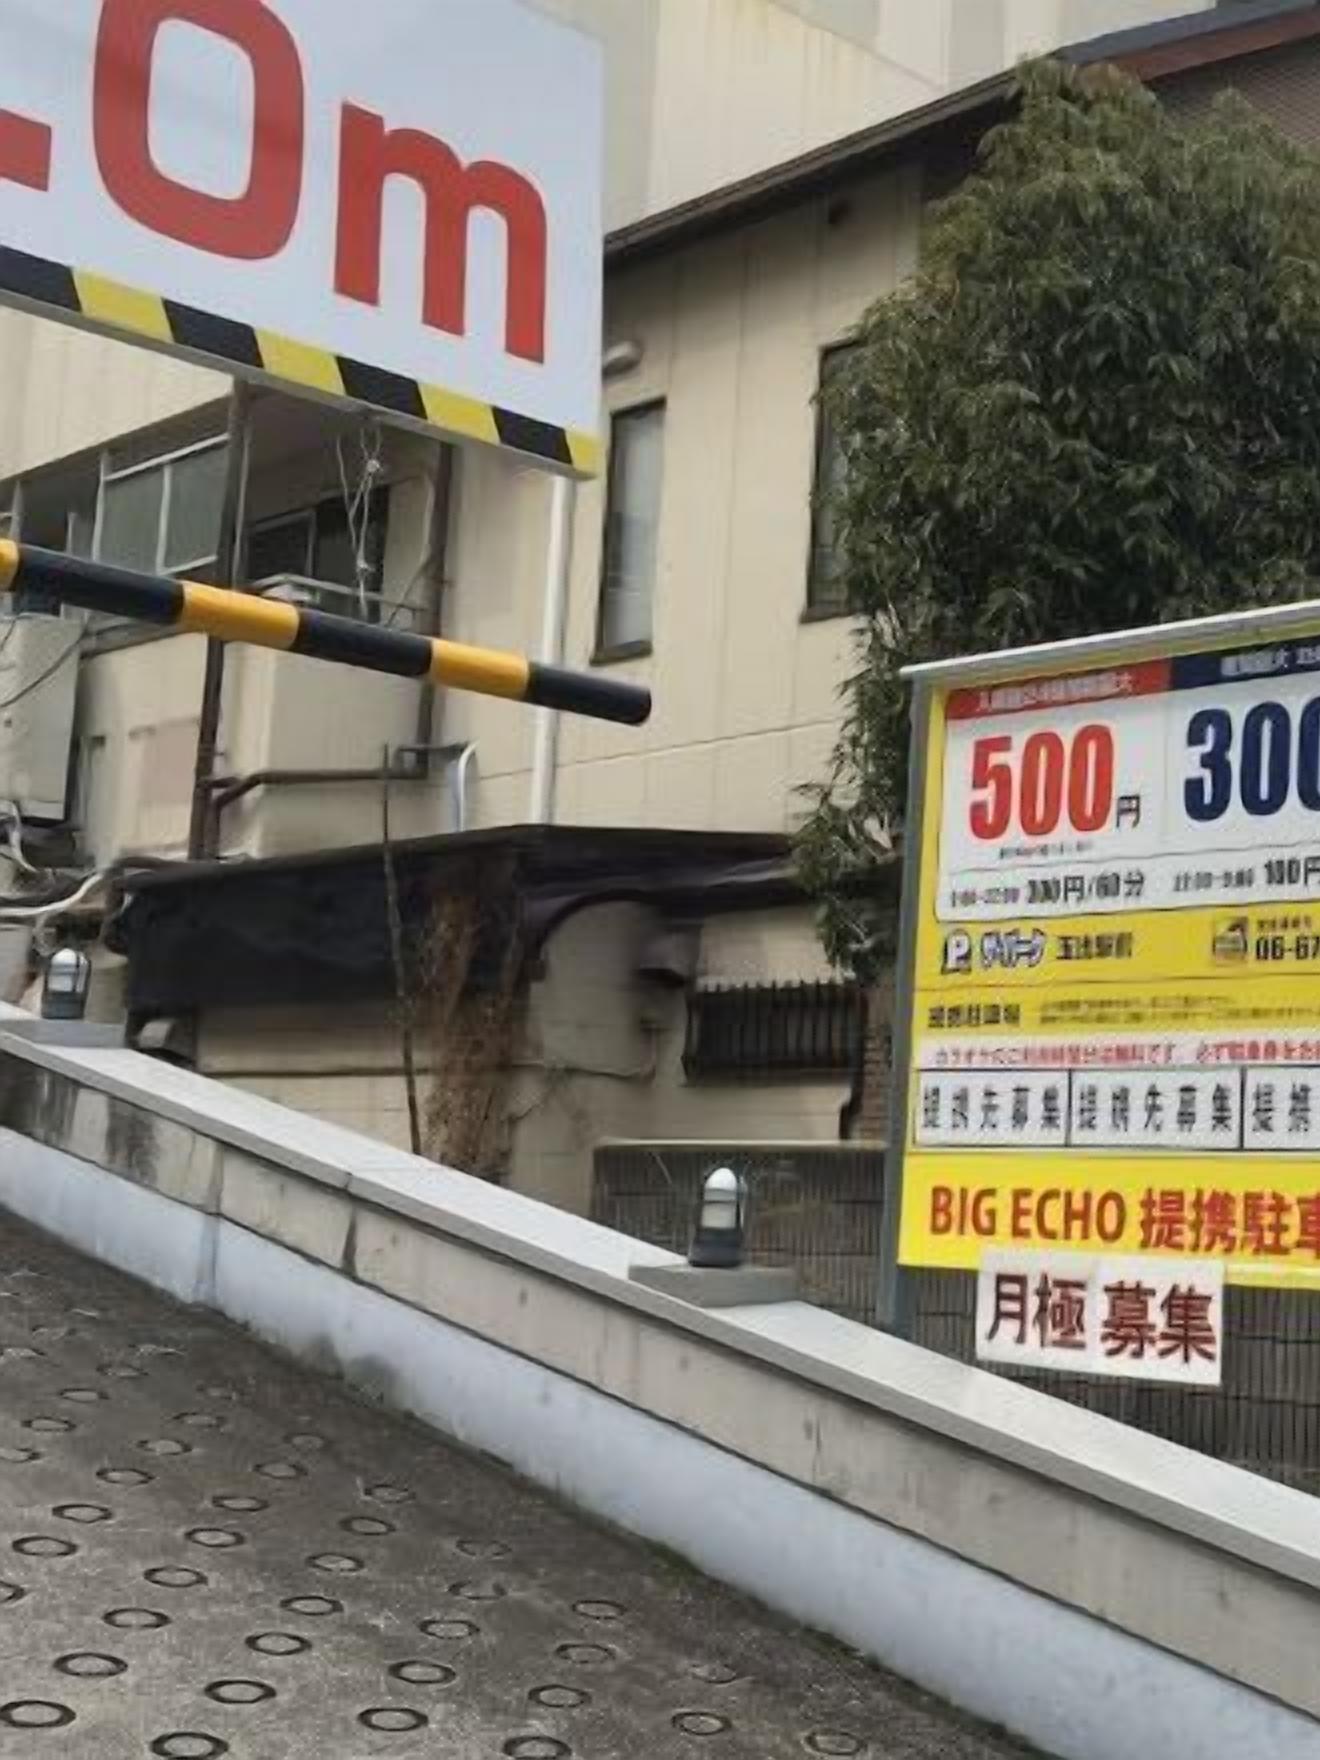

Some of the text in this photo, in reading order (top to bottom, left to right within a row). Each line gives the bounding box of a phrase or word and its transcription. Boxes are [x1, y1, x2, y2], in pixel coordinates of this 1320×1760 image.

[930, 1186, 999, 1236] BIG
[1010, 1188, 1127, 1242] ECHO
[985, 1271, 1218, 1365] 月極 募集
